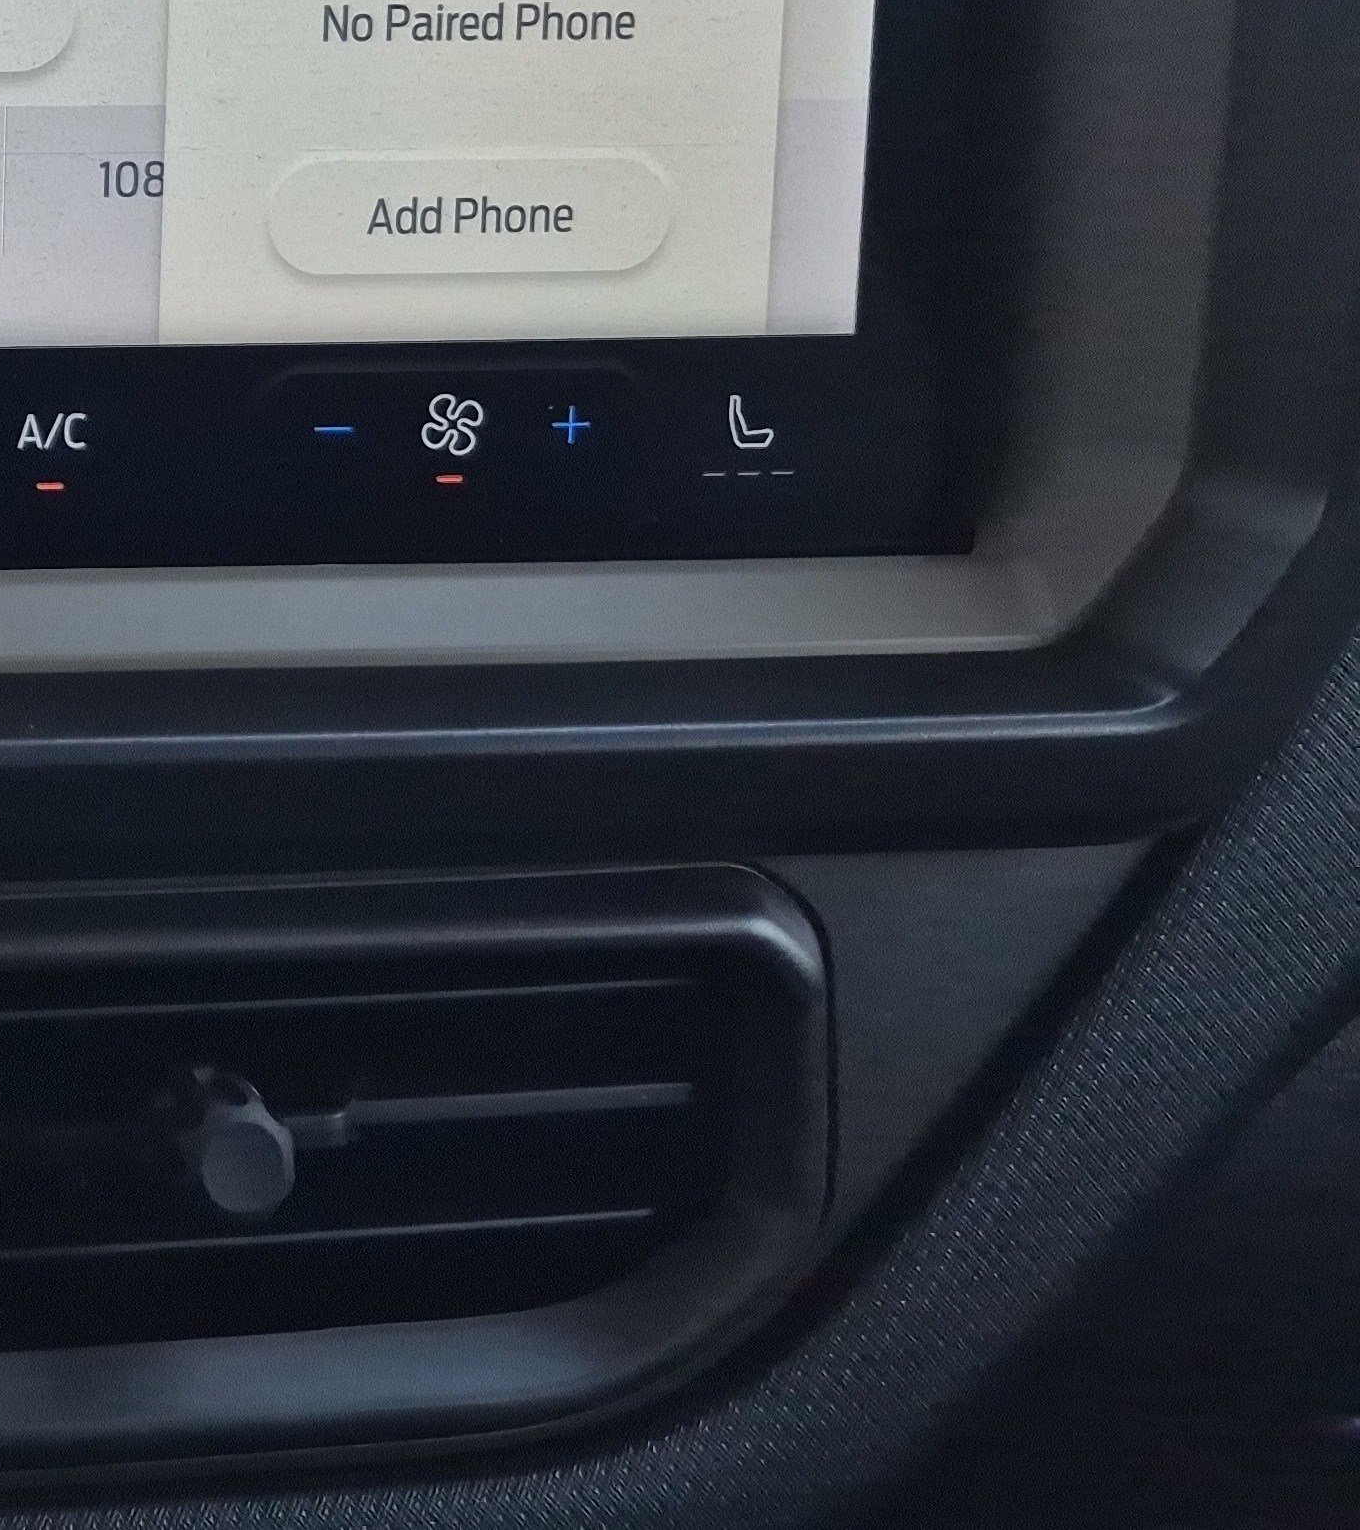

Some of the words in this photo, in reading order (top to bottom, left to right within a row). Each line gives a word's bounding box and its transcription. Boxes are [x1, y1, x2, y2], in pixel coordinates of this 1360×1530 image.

[321, 4, 373, 43] No
[385, 2, 505, 42] Paired
[515, 2, 636, 42] Phone
[367, 198, 443, 235] Add
[453, 197, 575, 234] Phone
[16, 413, 88, 451] A/C
